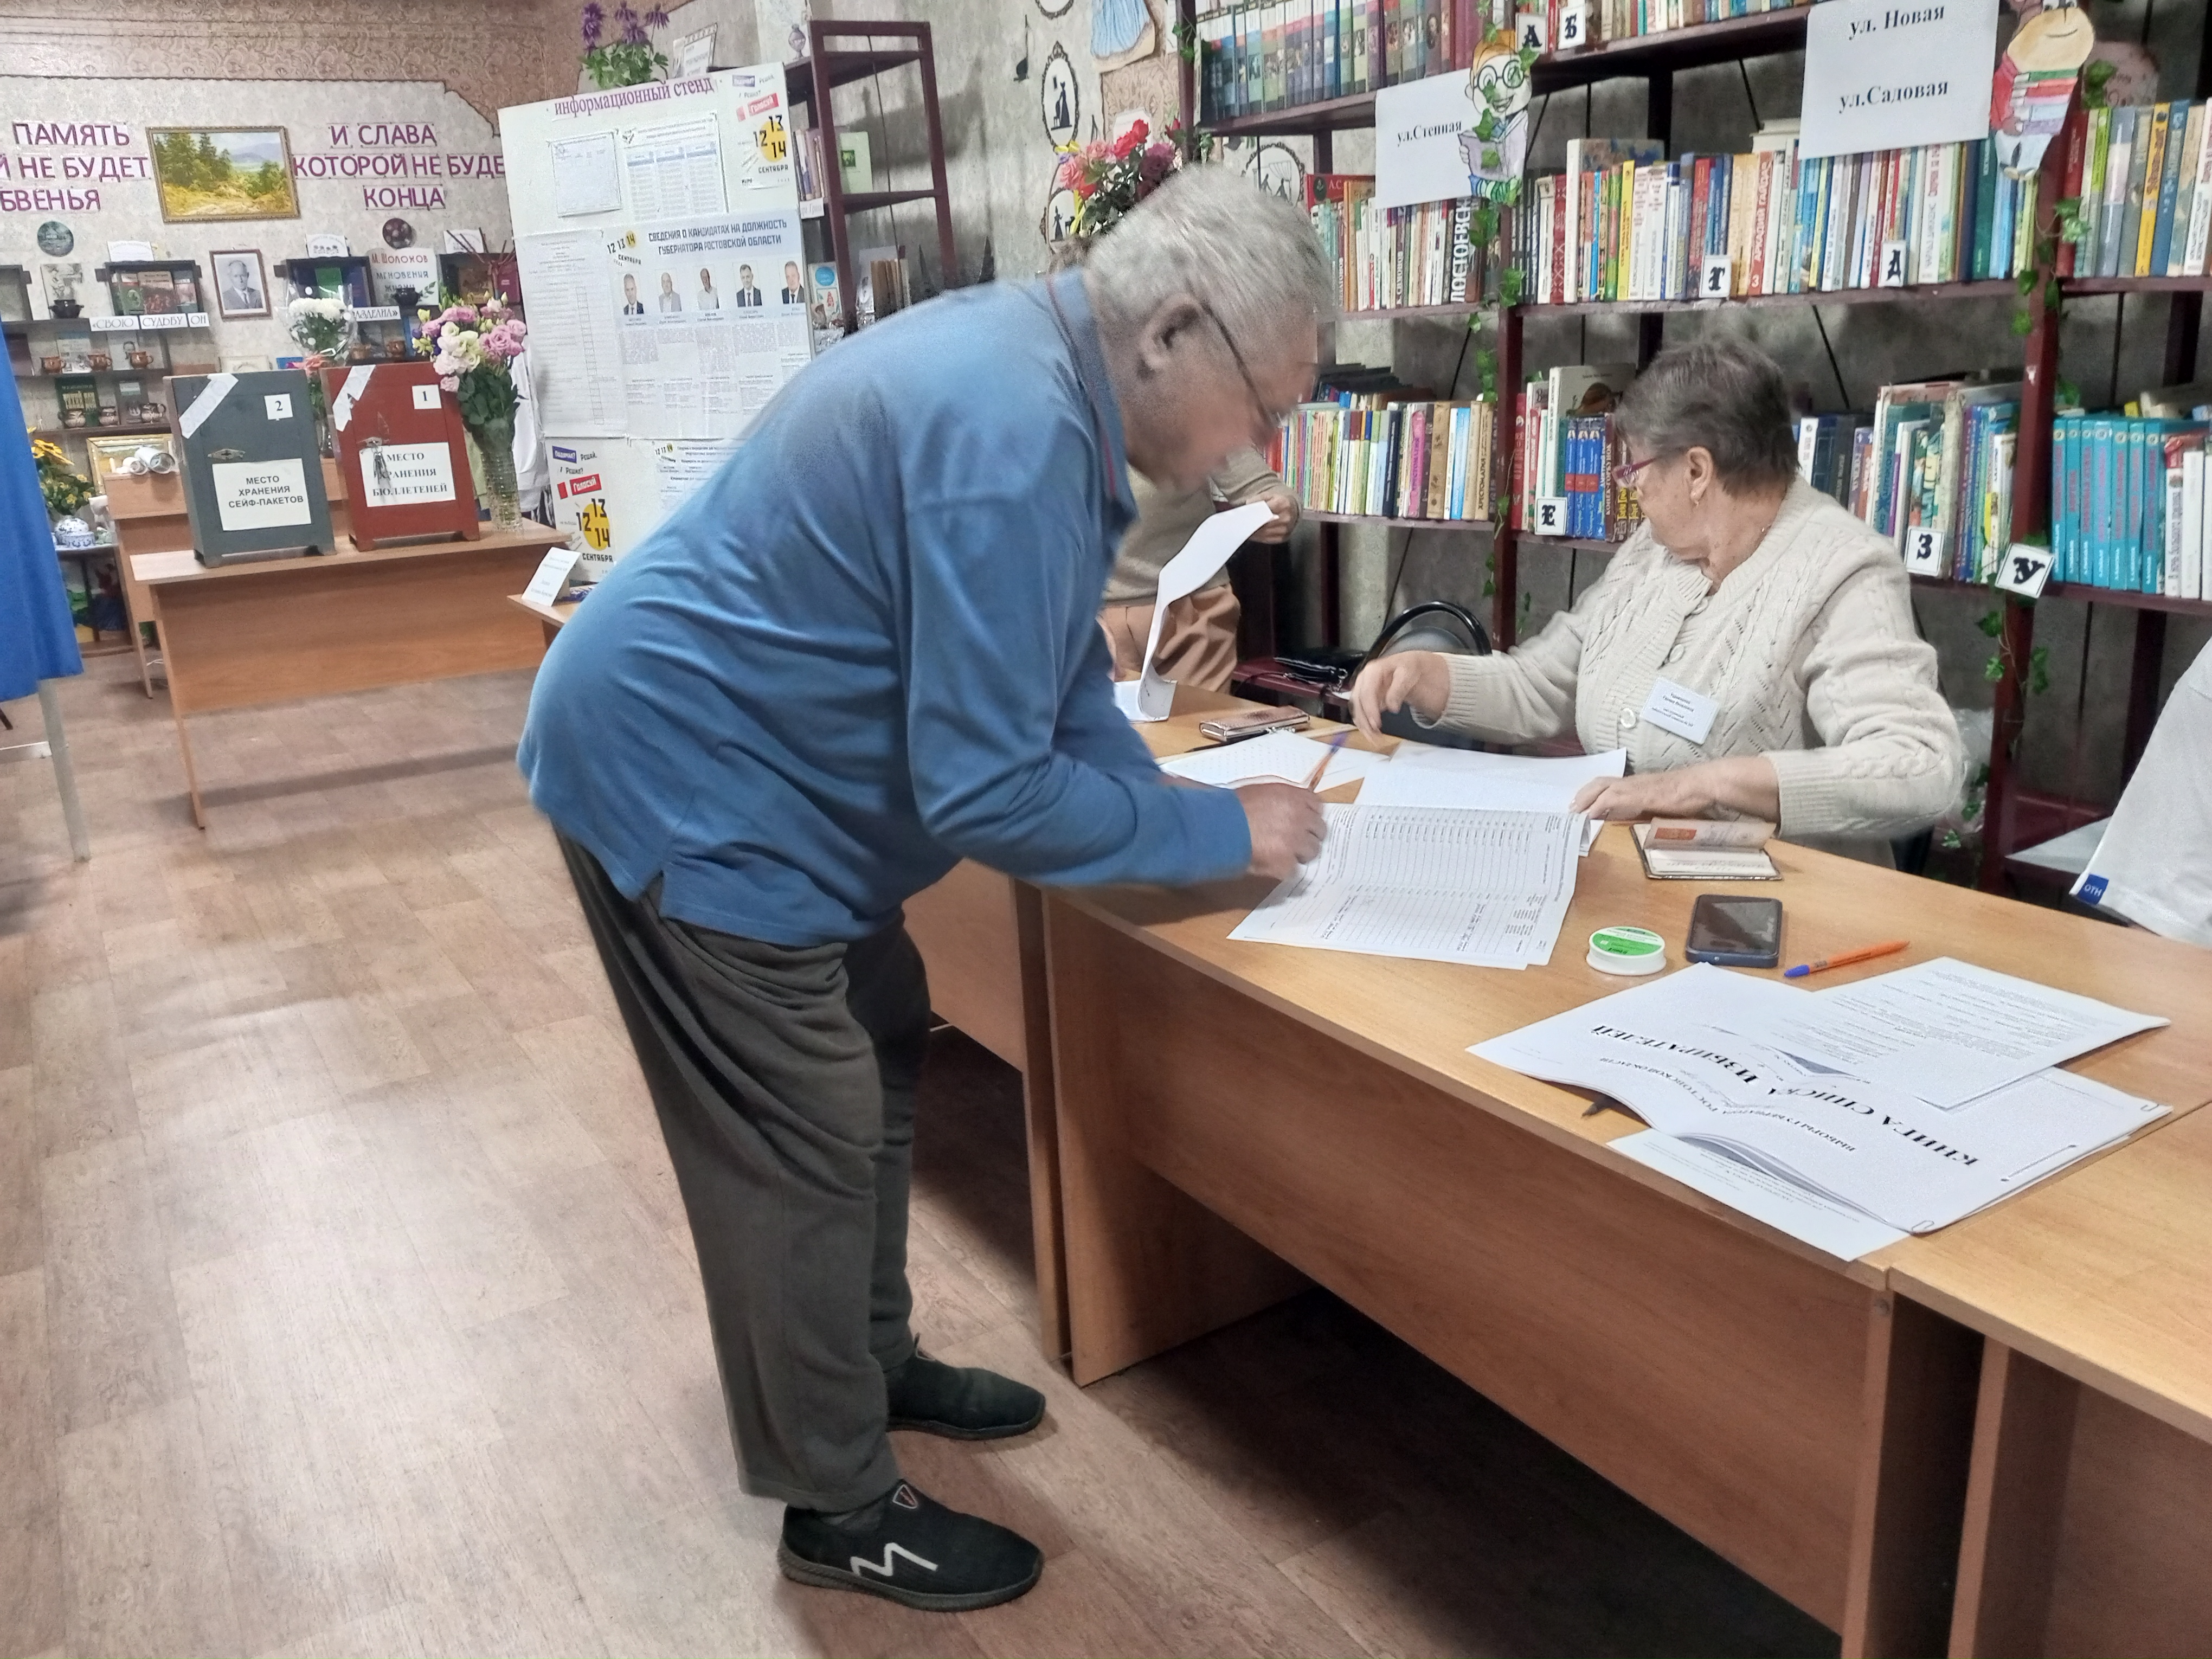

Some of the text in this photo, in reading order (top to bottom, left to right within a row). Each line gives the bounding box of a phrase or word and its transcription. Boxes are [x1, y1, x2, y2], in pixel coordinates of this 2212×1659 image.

[1849, 6, 1945, 39] ул. Новая
[555, 78, 715, 117] информационный стенд
[769, 114, 784, 132] 13
[12, 123, 130, 145] ПАМЯТЬ
[331, 124, 437, 146] И СЛАВА
[753, 130, 768, 147] 12
[771, 141, 787, 158] 14
[18, 157, 56, 179] НЕ
[62, 157, 148, 182] БУДЕТ
[293, 154, 408, 178] КОТОРОЙ
[413, 155, 441, 177] НЕ
[758, 164, 789, 173] СЕНТЯБРЯ
[363, 188, 445, 210] КОНЦА
[649, 230, 681, 242] СВЕДЕНИЯ
[688, 225, 730, 237] КАНДИДАТАХ
[731, 223, 741, 233] НА
[742, 219, 787, 234] ДОЛЖНОСТЬ
[607, 243, 616, 254] 12
[659, 234, 781, 255] ГУБЕРНАТОРА РОСТОВСКОЙ ОБЛАСТИ
[142, 317, 183, 329] СУДЬБУ
[191, 316, 206, 325] ОН
[353, 308, 398, 319] АЗДЕЛИЛ»
[275, 400, 283, 411] 2
[422, 391, 428, 402] 1
[387, 452, 425, 462] МЕСТО
[246, 475, 280, 485] МЕСТО
[239, 486, 290, 496] ХРАНЕНИЯ
[372, 483, 447, 496] БЮЛЛЕТЕНЕЙ
[229, 494, 304, 508] СЕЙФ-ПАКЕТОВ
[591, 498, 607, 517] 13
[576, 512, 591, 531] 12
[595, 528, 610, 548] 14
[582, 553, 613, 562] СЕНТЯБРЯ
[1590, 1024, 1760, 1084] ИЗБИРАТЕЛЕЙ
[1882, 1114, 1979, 1167] КНИГА
